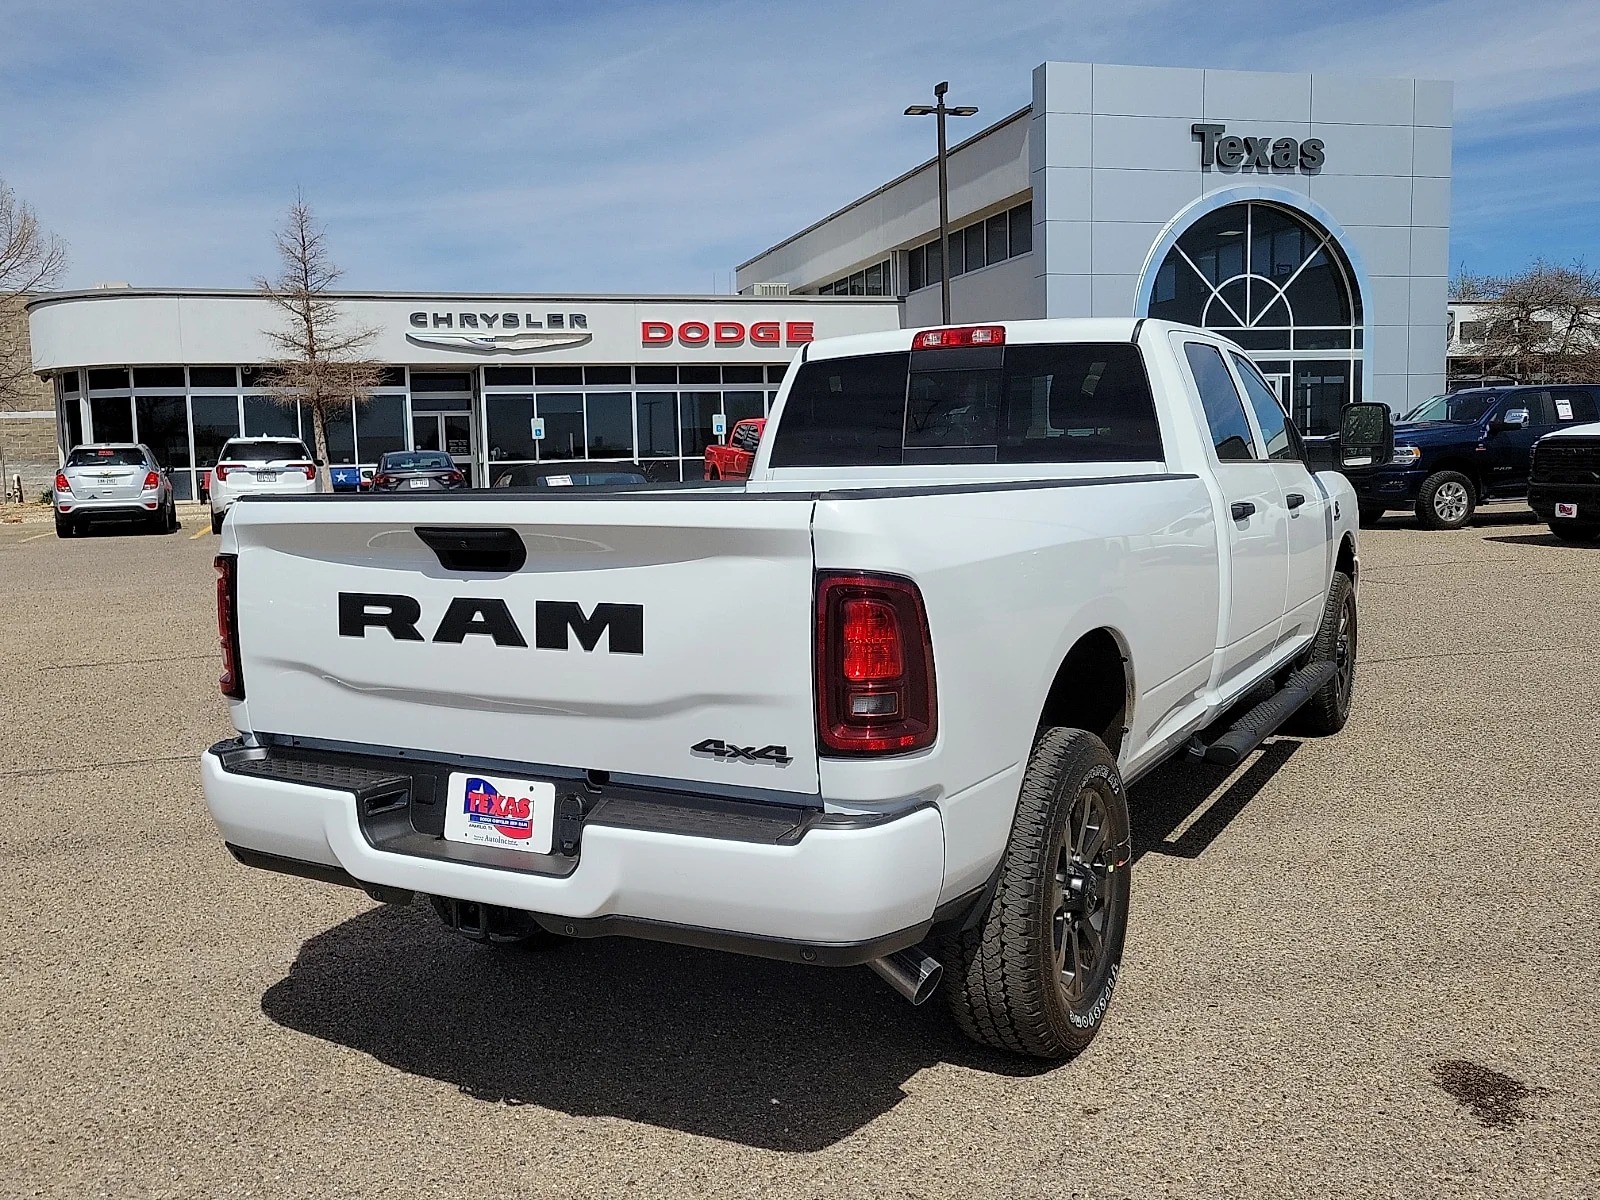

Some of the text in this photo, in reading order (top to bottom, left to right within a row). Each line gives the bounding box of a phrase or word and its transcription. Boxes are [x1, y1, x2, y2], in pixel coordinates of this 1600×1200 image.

[1191, 123, 1325, 172] Texas
[409, 312, 587, 330] CHRYSLER
[642, 321, 814, 346] DODGE
[338, 591, 644, 655] RAM
[690, 739, 793, 766] 4x4
[468, 792, 531, 818] TEXAS
